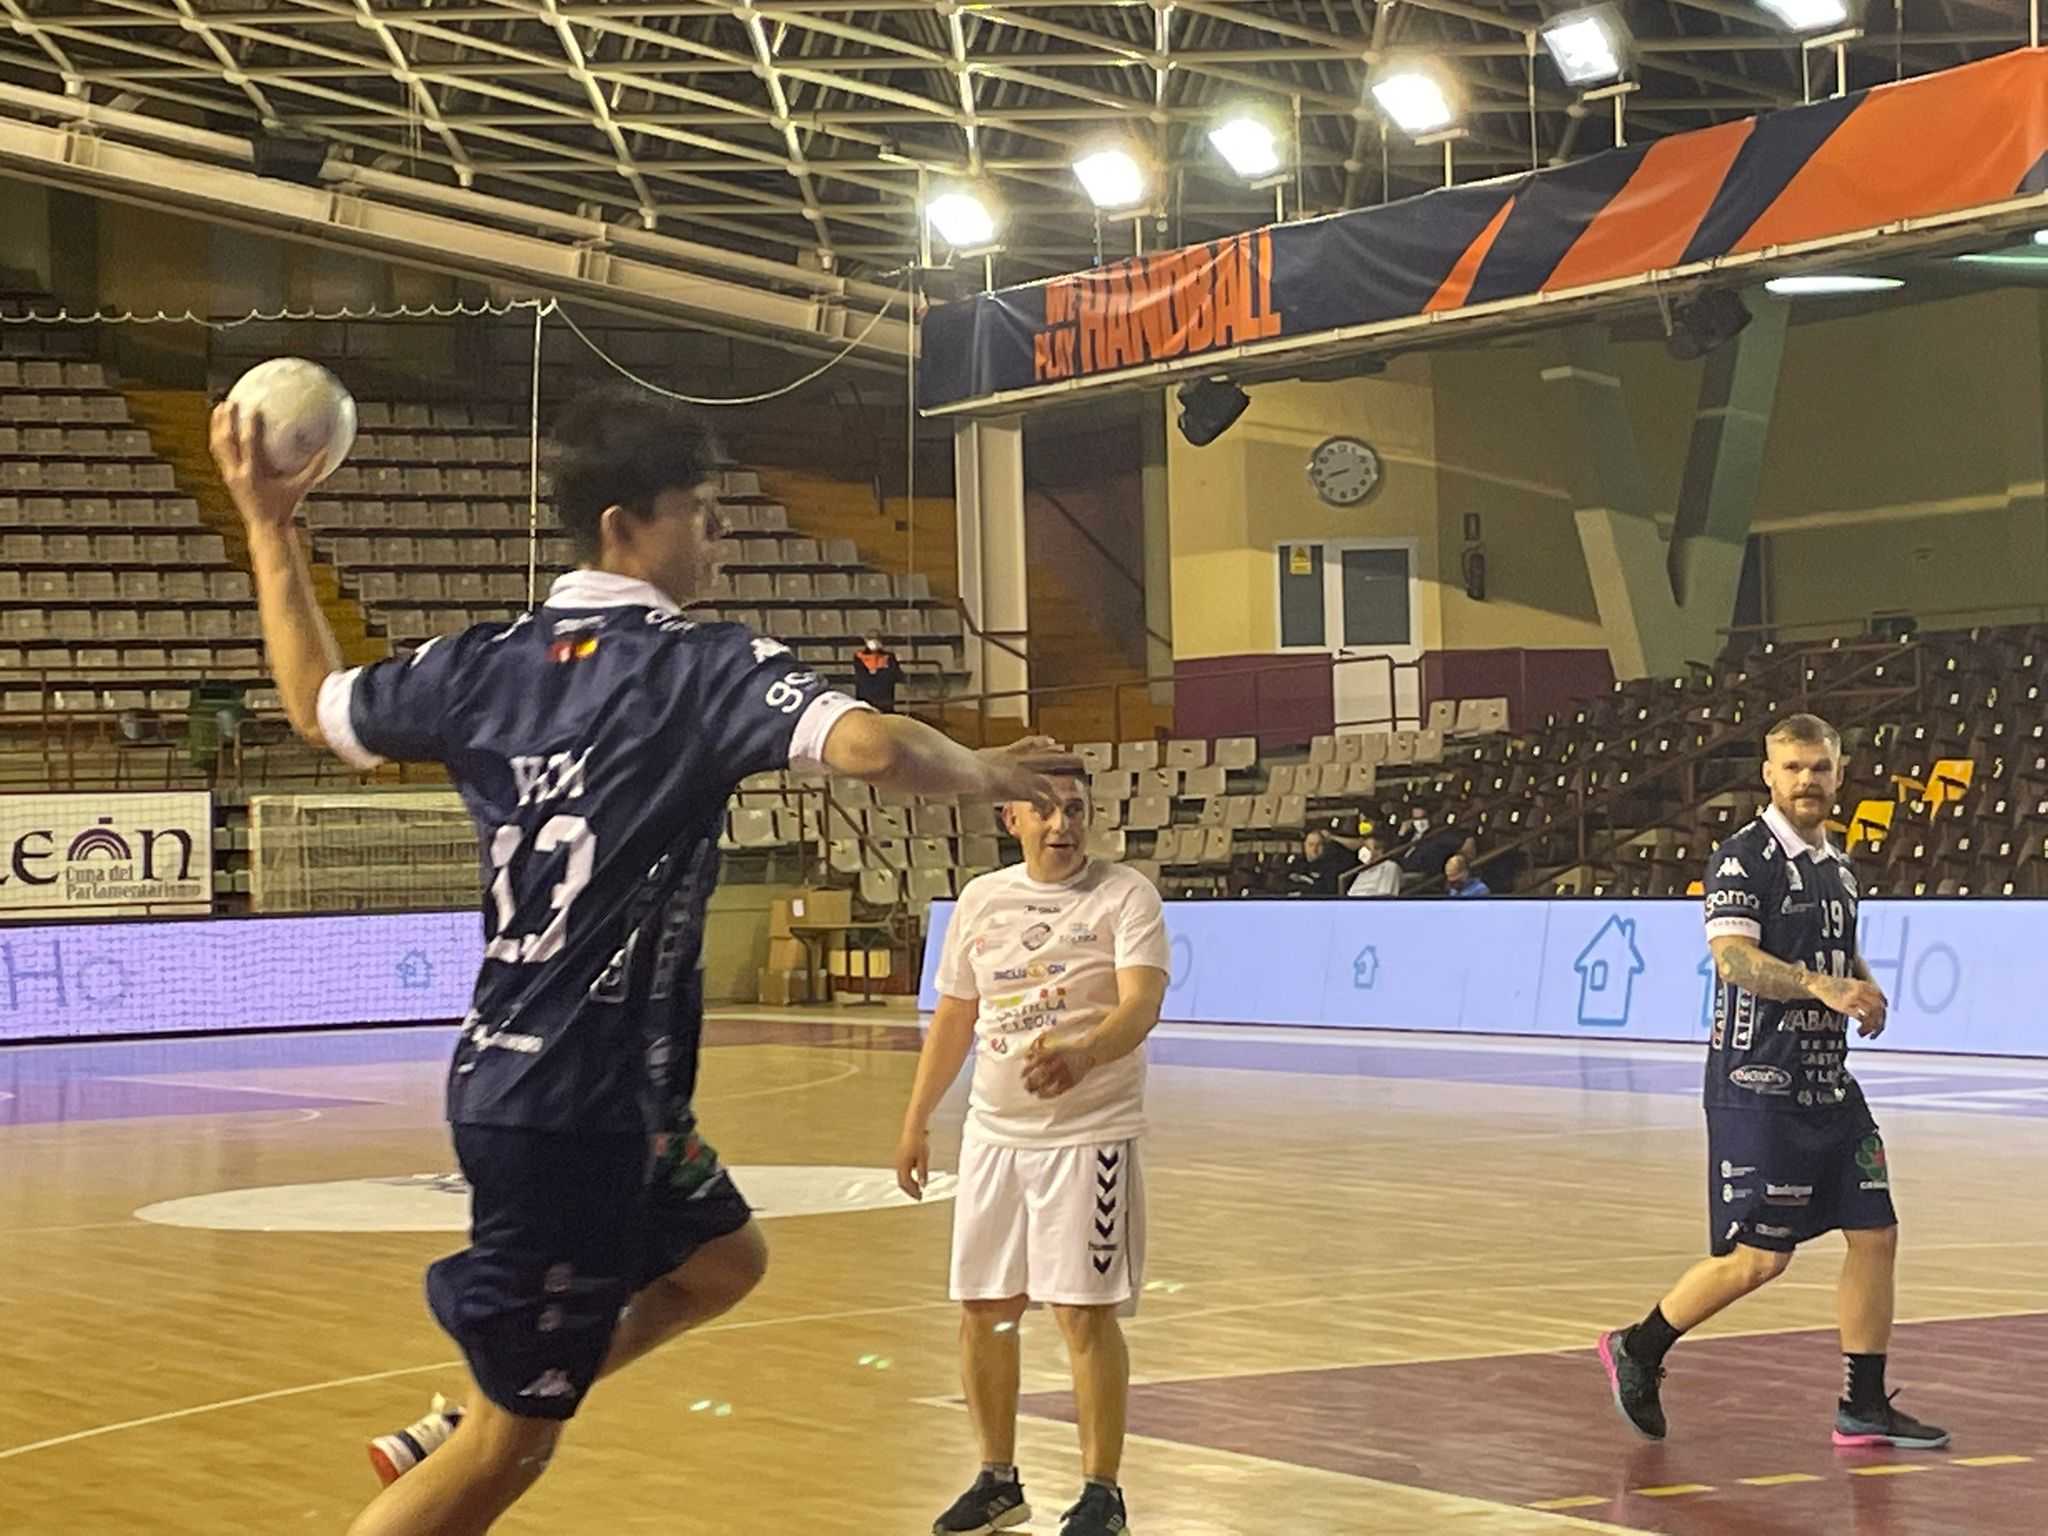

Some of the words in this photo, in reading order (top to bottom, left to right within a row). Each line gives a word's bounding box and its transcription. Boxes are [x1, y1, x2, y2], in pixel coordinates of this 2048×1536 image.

[1045, 284, 1077, 325] WE
[1080, 228, 1281, 373] HANDBALL
[1034, 327, 1076, 382] PLAY
[0, 816, 201, 885] eón
[66, 865, 105, 882] Cuna
[109, 864, 134, 881] del
[66, 882, 201, 901] Parlamentarismo
[1821, 898, 1844, 939] 19
